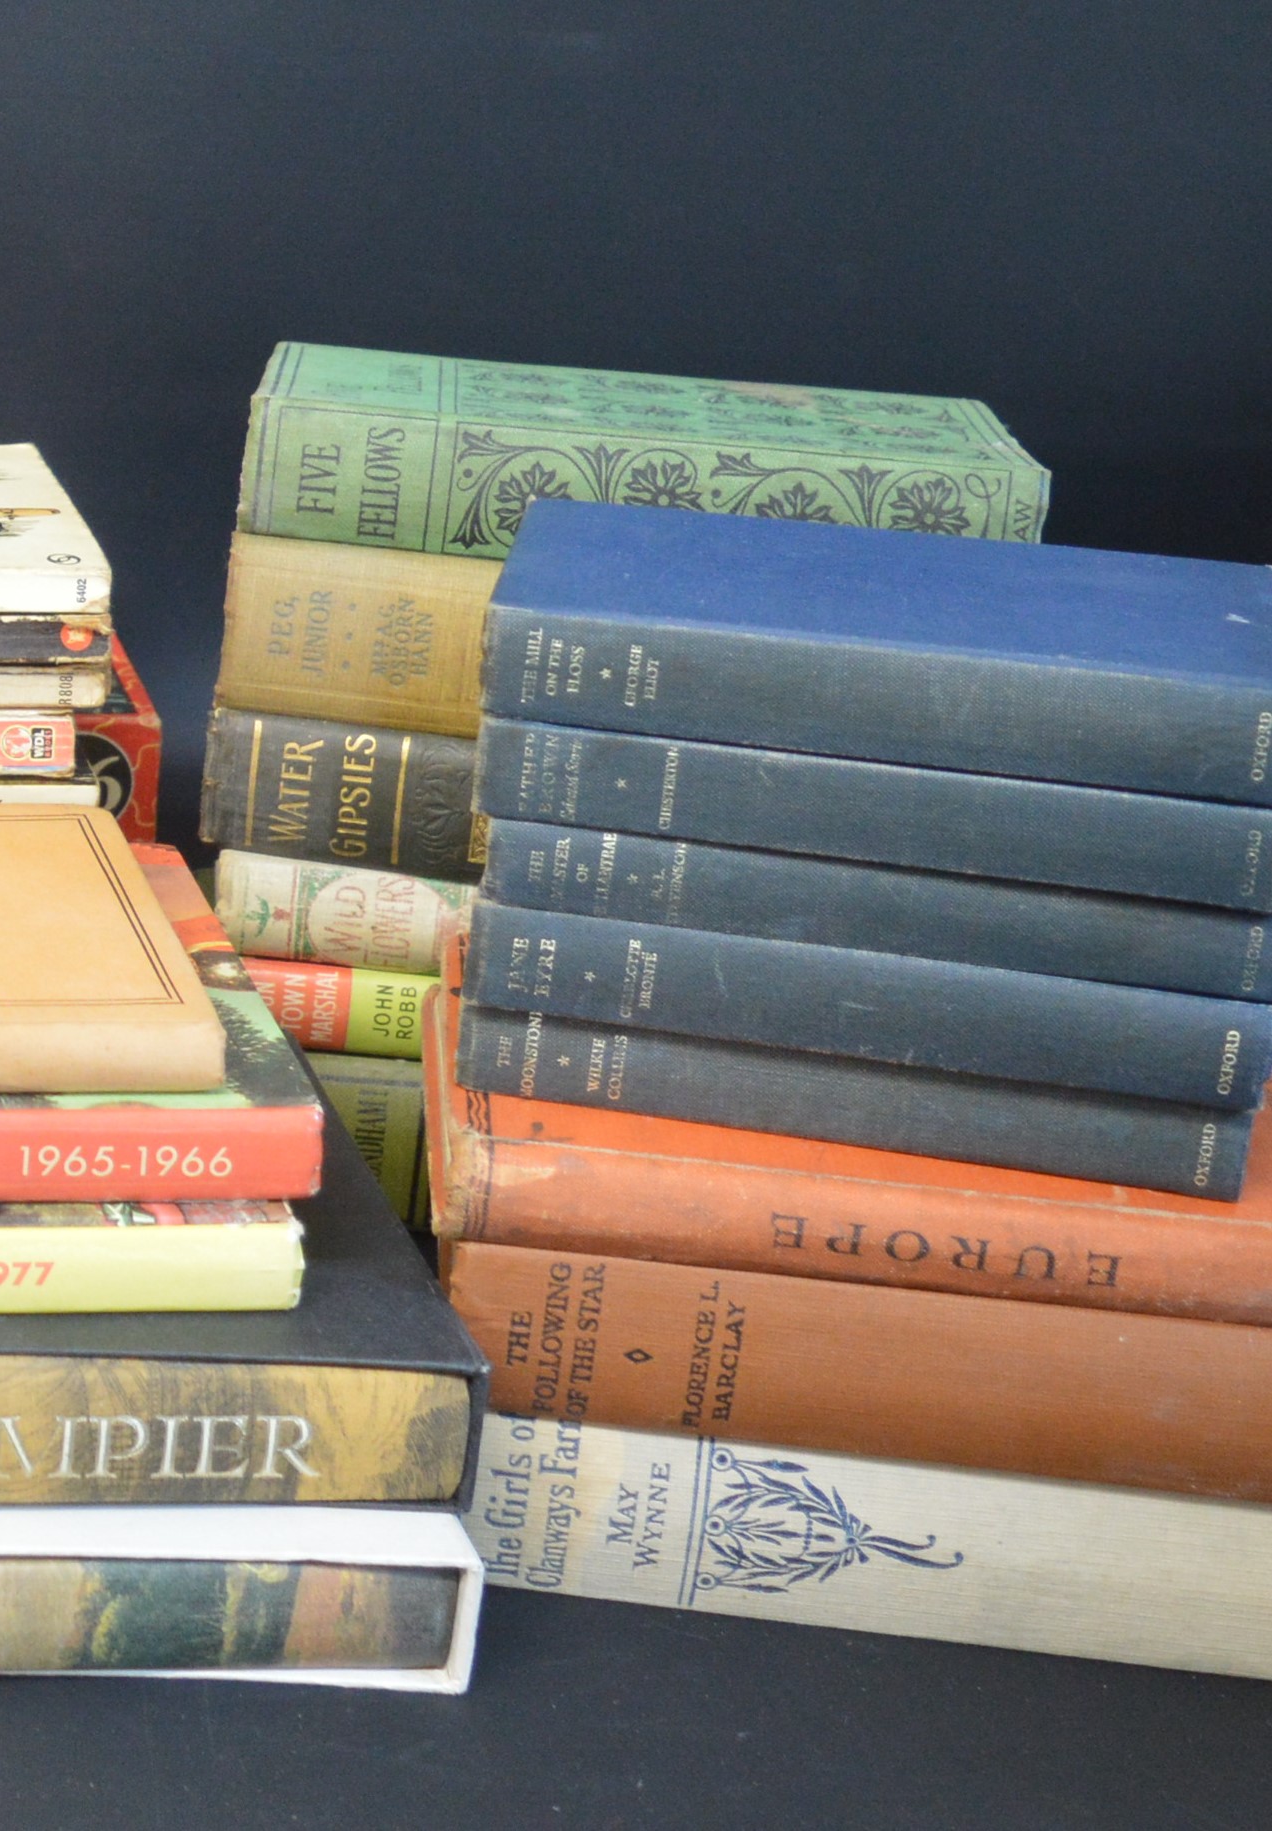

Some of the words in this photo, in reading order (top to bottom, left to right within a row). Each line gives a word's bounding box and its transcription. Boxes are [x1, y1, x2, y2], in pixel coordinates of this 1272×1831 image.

[296, 442, 341, 516] FIVE
[357, 426, 406, 541] FELLOWS
[76, 577, 87, 604] 6402
[301, 589, 333, 678] JUNIOR
[388, 597, 417, 689] OSBORN
[412, 611, 434, 677] HANN
[525, 627, 544, 667] MILL
[550, 637, 564, 670] THE
[545, 673, 558, 697] ON
[566, 645, 585, 694] FLOSS
[624, 644, 643, 707] GEORGE
[643, 657, 660, 701] ELIOT
[32, 728, 44, 759] WDL
[1250, 710, 1272, 783] OXFORD
[267, 739, 325, 843] WATER
[329, 732, 377, 858] GIPSIES
[324, 885, 367, 954] WILD
[363, 876, 416, 967] FLOWERS
[534, 938, 556, 998] EYRE
[280, 974, 306, 1030] TOWN
[310, 971, 339, 1043] MARSHAL
[372, 984, 394, 1037] JOHN
[395, 986, 418, 1040] ROBB
[497, 1035, 513, 1068] THE
[586, 1037, 605, 1092] WILKIE
[1216, 1028, 1242, 1097] OXFORD
[18, 1144, 233, 1178] 1965-1966
[1193, 1121, 1217, 1188] OXFORD
[771, 1211, 1123, 1287] EUROPE
[578, 1262, 606, 1335] STAR
[507, 1309, 533, 1368] THE
[532, 1261, 572, 1416] FOLLOWING
[571, 1336, 596, 1390] THE
[682, 1311, 717, 1428] FLORENCE
[712, 1300, 746, 1422] BARCLAY
[566, 1390, 587, 1418] OF
[483, 1452, 533, 1530] Girls
[606, 1483, 640, 1546] MAY
[632, 1462, 672, 1571] WYNNE
[525, 1483, 582, 1588] Clanways
